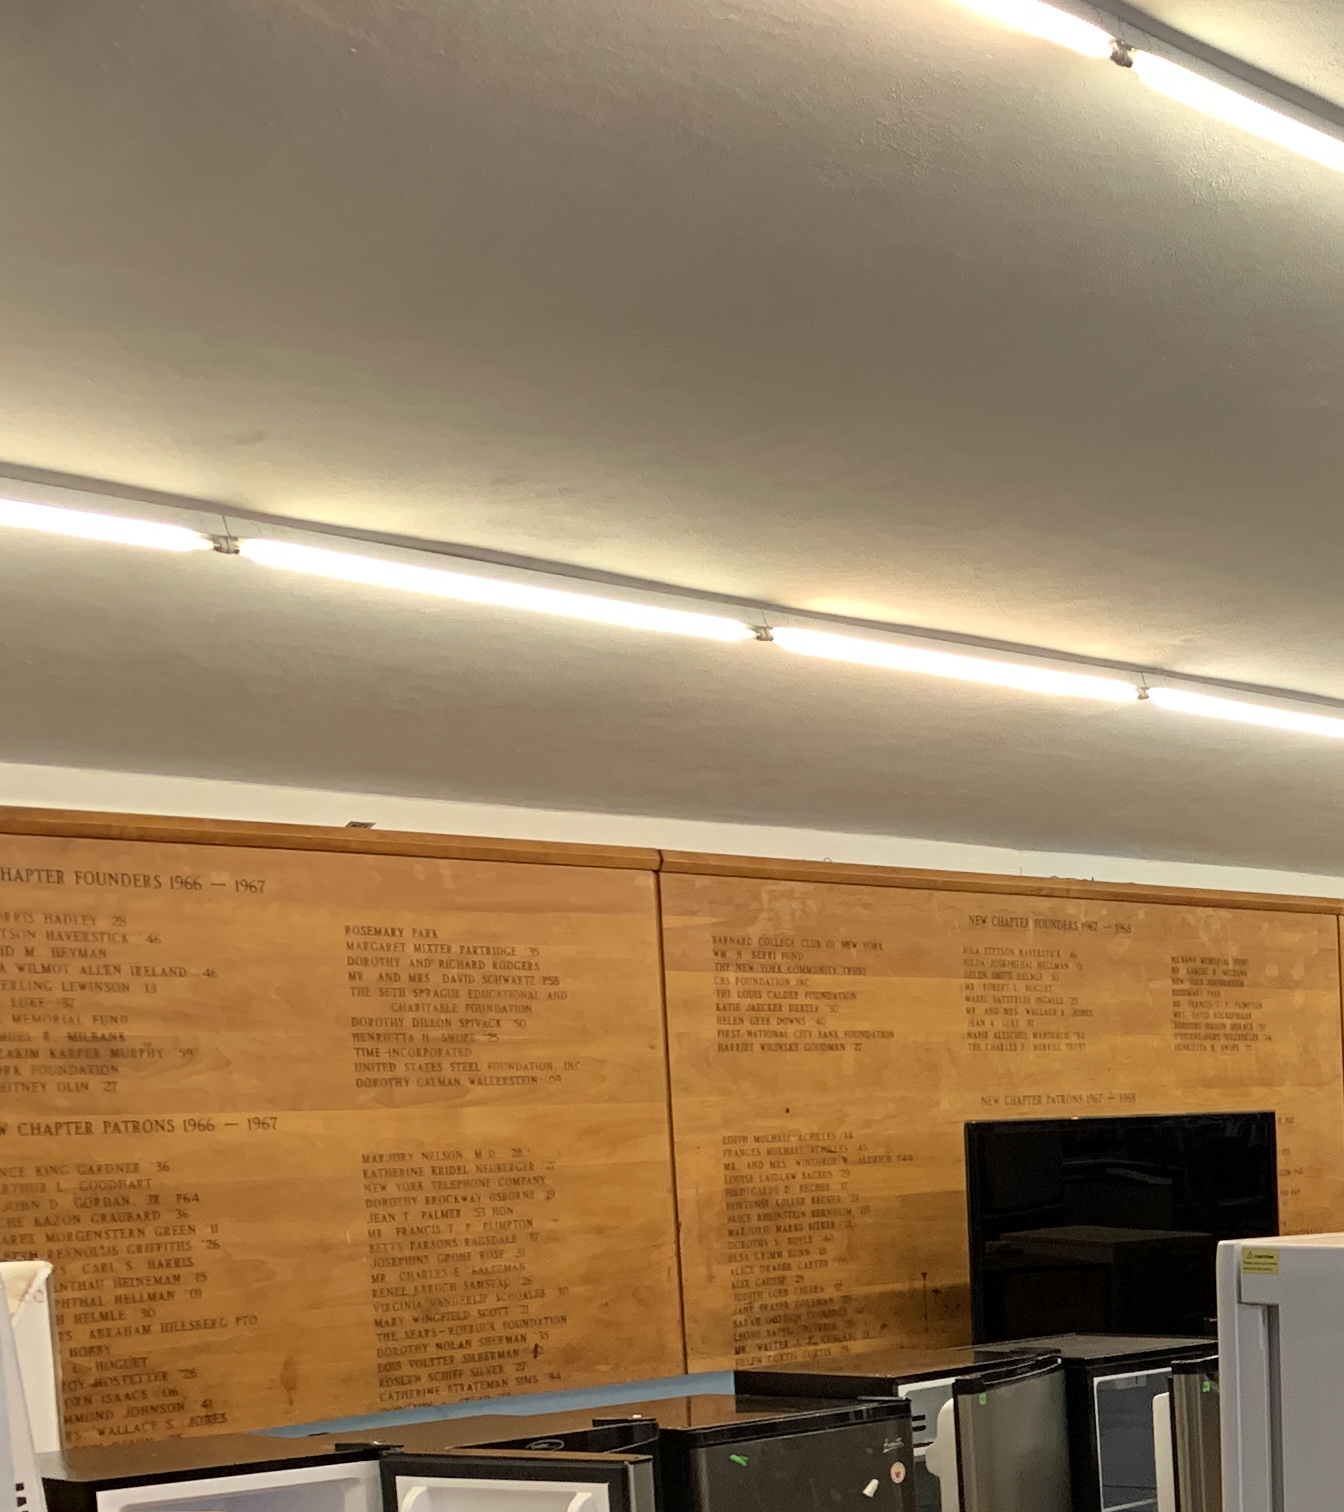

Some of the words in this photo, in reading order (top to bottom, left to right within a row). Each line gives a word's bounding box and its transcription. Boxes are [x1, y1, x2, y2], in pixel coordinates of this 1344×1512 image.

[0, 867, 65, 885] HAPTER
[74, 870, 163, 890] FOUNDERS
[169, 876, 203, 891] 1966
[234, 879, 266, 894] 1967
[43, 915, 97, 927] HADLEY
[969, 915, 986, 925] NEW
[992, 916, 1029, 928] CHAPTER
[1035, 918, 1078, 931] FOUNDERS
[46, 929, 129, 944] HAVERSTICK
[344, 925, 404, 937] ROSEMARY
[412, 928, 439, 938] PARK
[345, 941, 405, 952] MARGARET
[414, 943, 452, 954] MIXTER
[460, 945, 516, 956] PARTRIDGE
[712, 935, 753, 945] BARNARD
[758, 937, 795, 947] COLLEGE
[801, 939, 821, 948] CLUB
[841, 941, 857, 949] NEW
[863, 942, 884, 950] YORK
[51, 948, 107, 959] HEYMAN
[80, 962, 121, 975] ALLEN
[130, 965, 187, 977] IRELAND
[346, 956, 400, 968] DOROTHY
[409, 958, 431, 968] AND
[439, 959, 485, 970] RICHARD
[492, 961, 540, 971] RODGERS
[715, 963, 730, 972] THE
[736, 963, 754, 972] NEW
[760, 964, 782, 973] YORK
[788, 965, 837, 974] COMMUNITY
[843, 966, 867, 975] TRUST
[377, 972, 401, 982] AND
[442, 973, 475, 984] DAVID
[482, 975, 536, 985] SCHWARTZ
[715, 977, 730, 985] CBS
[736, 977, 791, 986] FOUNDATION
[61, 981, 130, 993] LEWINSON
[350, 987, 371, 997] THE
[378, 987, 405, 997] SETH
[413, 988, 460, 998] SPRAGUE
[468, 989, 539, 999] EDUCATIONAL
[547, 990, 568, 1000] AND
[716, 990, 731, 998] THE
[738, 991, 762, 999] LOUIS
[767, 991, 799, 999] CALDER
[805, 992, 857, 1000] FOUNDATION
[391, 1003, 458, 1013] CHARITABLE
[465, 1003, 533, 1014] FOUNDATION
[12, 1014, 83, 1025] MEMORIAL
[92, 1015, 128, 1024] FUND
[351, 1017, 404, 1028] DOROTHY
[412, 1018, 452, 1028] DILLON
[459, 1018, 502, 1028] SPIVACK
[717, 1017, 744, 1025] HELEN
[777, 1017, 806, 1025] DOWNS
[352, 1032, 414, 1043] HENRIETTA
[717, 1030, 741, 1038] FIRST
[747, 1030, 788, 1038] NATIONAL
[794, 1030, 812, 1038] CITY
[844, 1031, 894, 1039] FOUNDATION
[110, 1047, 164, 1059] MURPHY
[355, 1047, 381, 1058] TIME
[388, 1047, 472, 1058] INCORPORATED
[718, 1044, 754, 1052] HARRIET
[805, 1043, 845, 1051] GOODMAN
[31, 1064, 119, 1076] FOUNDATION
[355, 1062, 396, 1073] UNITED
[405, 1062, 443, 1073] STATES
[450, 1061, 481, 1072] STEEL
[488, 1061, 552, 1071] FOUNDATION
[57, 1080, 89, 1093] OLIN
[356, 1077, 410, 1088] DOROTHY
[468, 1075, 538, 1087] WALLERSTEIN
[981, 1096, 999, 1105] NEW
[1004, 1095, 1042, 1105] CHAPTER
[1047, 1094, 1083, 1105] PATRONS
[17, 1120, 94, 1137] CHAPTER
[103, 1119, 175, 1134] PATRONS
[182, 1117, 215, 1133] 1966
[247, 1117, 278, 1131] 1967
[722, 1136, 748, 1144] EDITH
[798, 1132, 836, 1141] ACHILLES
[422, 1150, 463, 1161] NELSON
[723, 1148, 761, 1157] FRANCES
[35, 1164, 68, 1177] KING
[76, 1162, 140, 1176] GARDNER
[363, 1166, 424, 1179] KATHERINE
[80, 1178, 152, 1192] GOODHART
[364, 1183, 387, 1194] NEW
[396, 1182, 423, 1192] YORK
[431, 1179, 491, 1190] TELEPHONE
[498, 1175, 546, 1187] COMPANY
[365, 1196, 418, 1209] DOROTHY
[489, 1191, 535, 1203] OSBORNE
[368, 1213, 395, 1224] JEAN
[421, 1209, 461, 1220] PALMER
[46, 1227, 145, 1243] MORGENSTERN
[154, 1225, 197, 1237] GREEN
[396, 1225, 441, 1238] FRANCIS
[127, 1241, 193, 1256] GRIFFITHS
[369, 1243, 402, 1254] BETTY
[410, 1239, 458, 1251] PARSONS
[465, 1234, 517, 1247] RAGSDALE
[148, 1257, 194, 1270] HARRIS
[371, 1255, 429, 1268] JOSEPHINE
[114, 1291, 175, 1306] HELLMAN
[374, 1315, 403, 1328] MARY
[376, 1332, 402, 1342] THE
[503, 1315, 567, 1330] FOUNDATION
[377, 1344, 429, 1358] DOROTHY
[435, 1338, 472, 1351] NOLAN
[479, 1333, 527, 1346] SHERMAN
